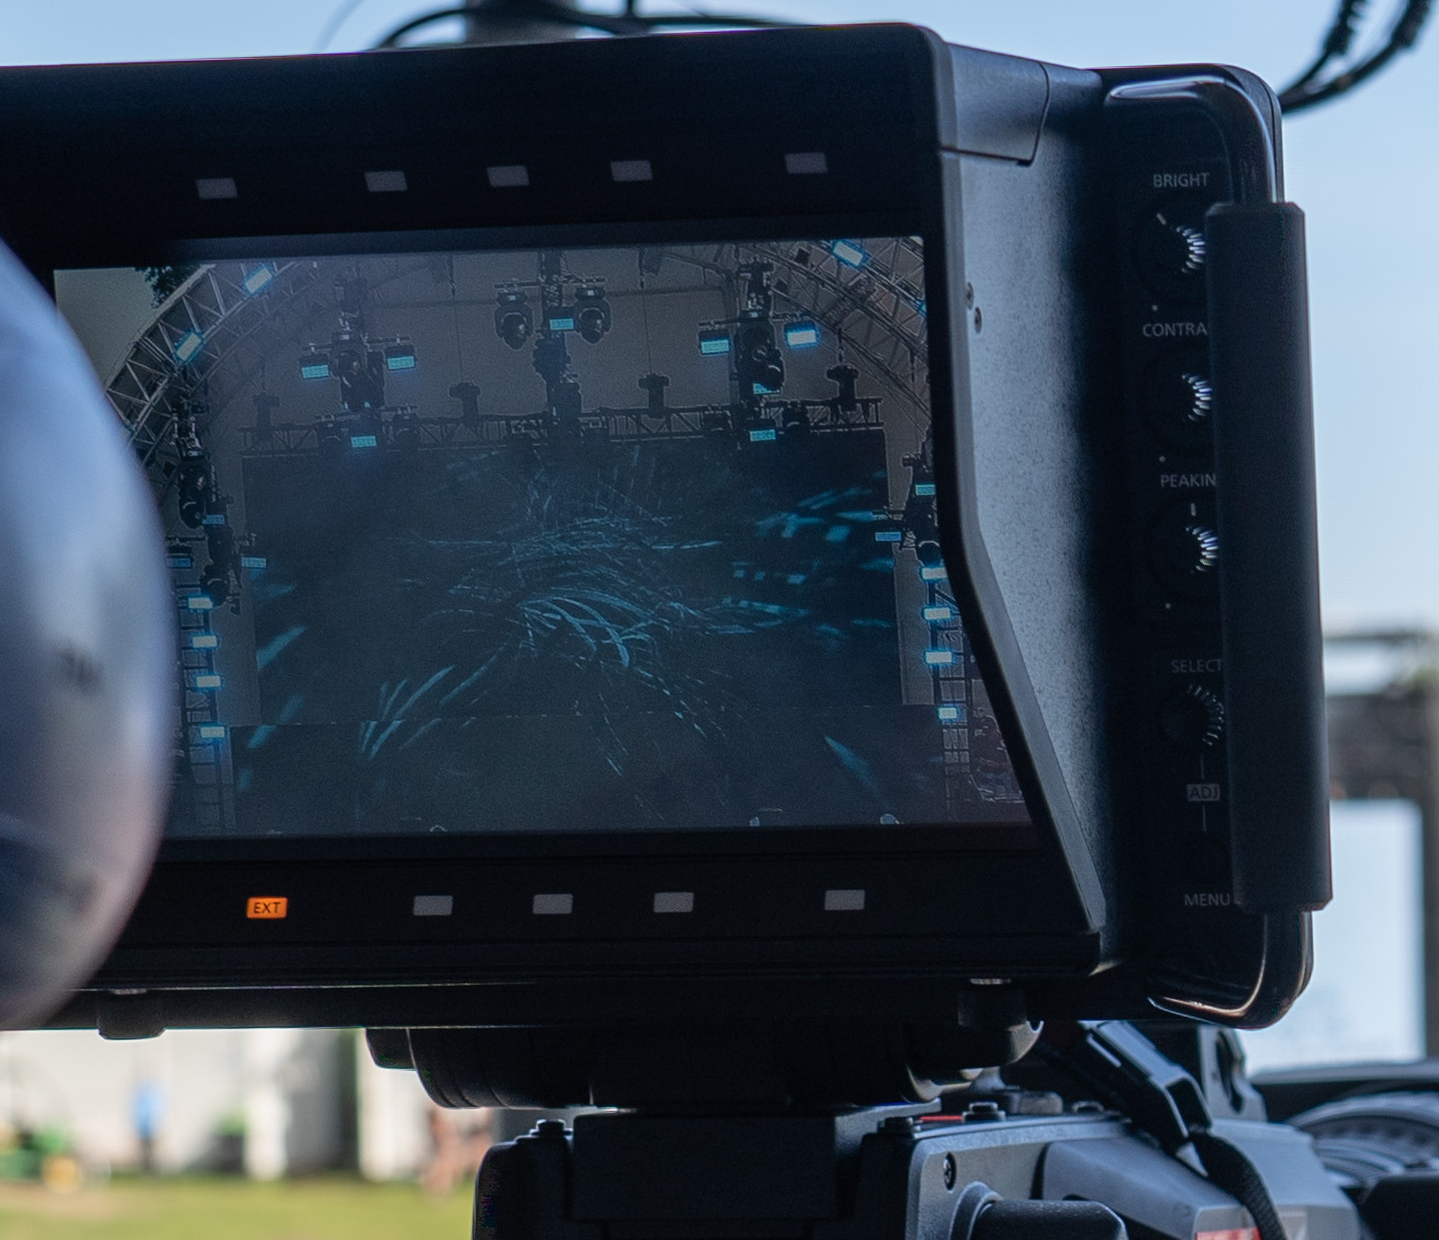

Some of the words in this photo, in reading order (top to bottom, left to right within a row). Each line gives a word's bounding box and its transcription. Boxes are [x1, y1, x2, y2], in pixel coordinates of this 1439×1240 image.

[1152, 172, 1210, 188] BRIGHT
[1142, 321, 1208, 338] CONTRA
[1160, 473, 1217, 489] PEAKIN
[1171, 658, 1223, 674] SELECT
[1189, 786, 1218, 799] ADJ
[253, 902, 281, 914] EXT
[1184, 893, 1231, 907] MENU
